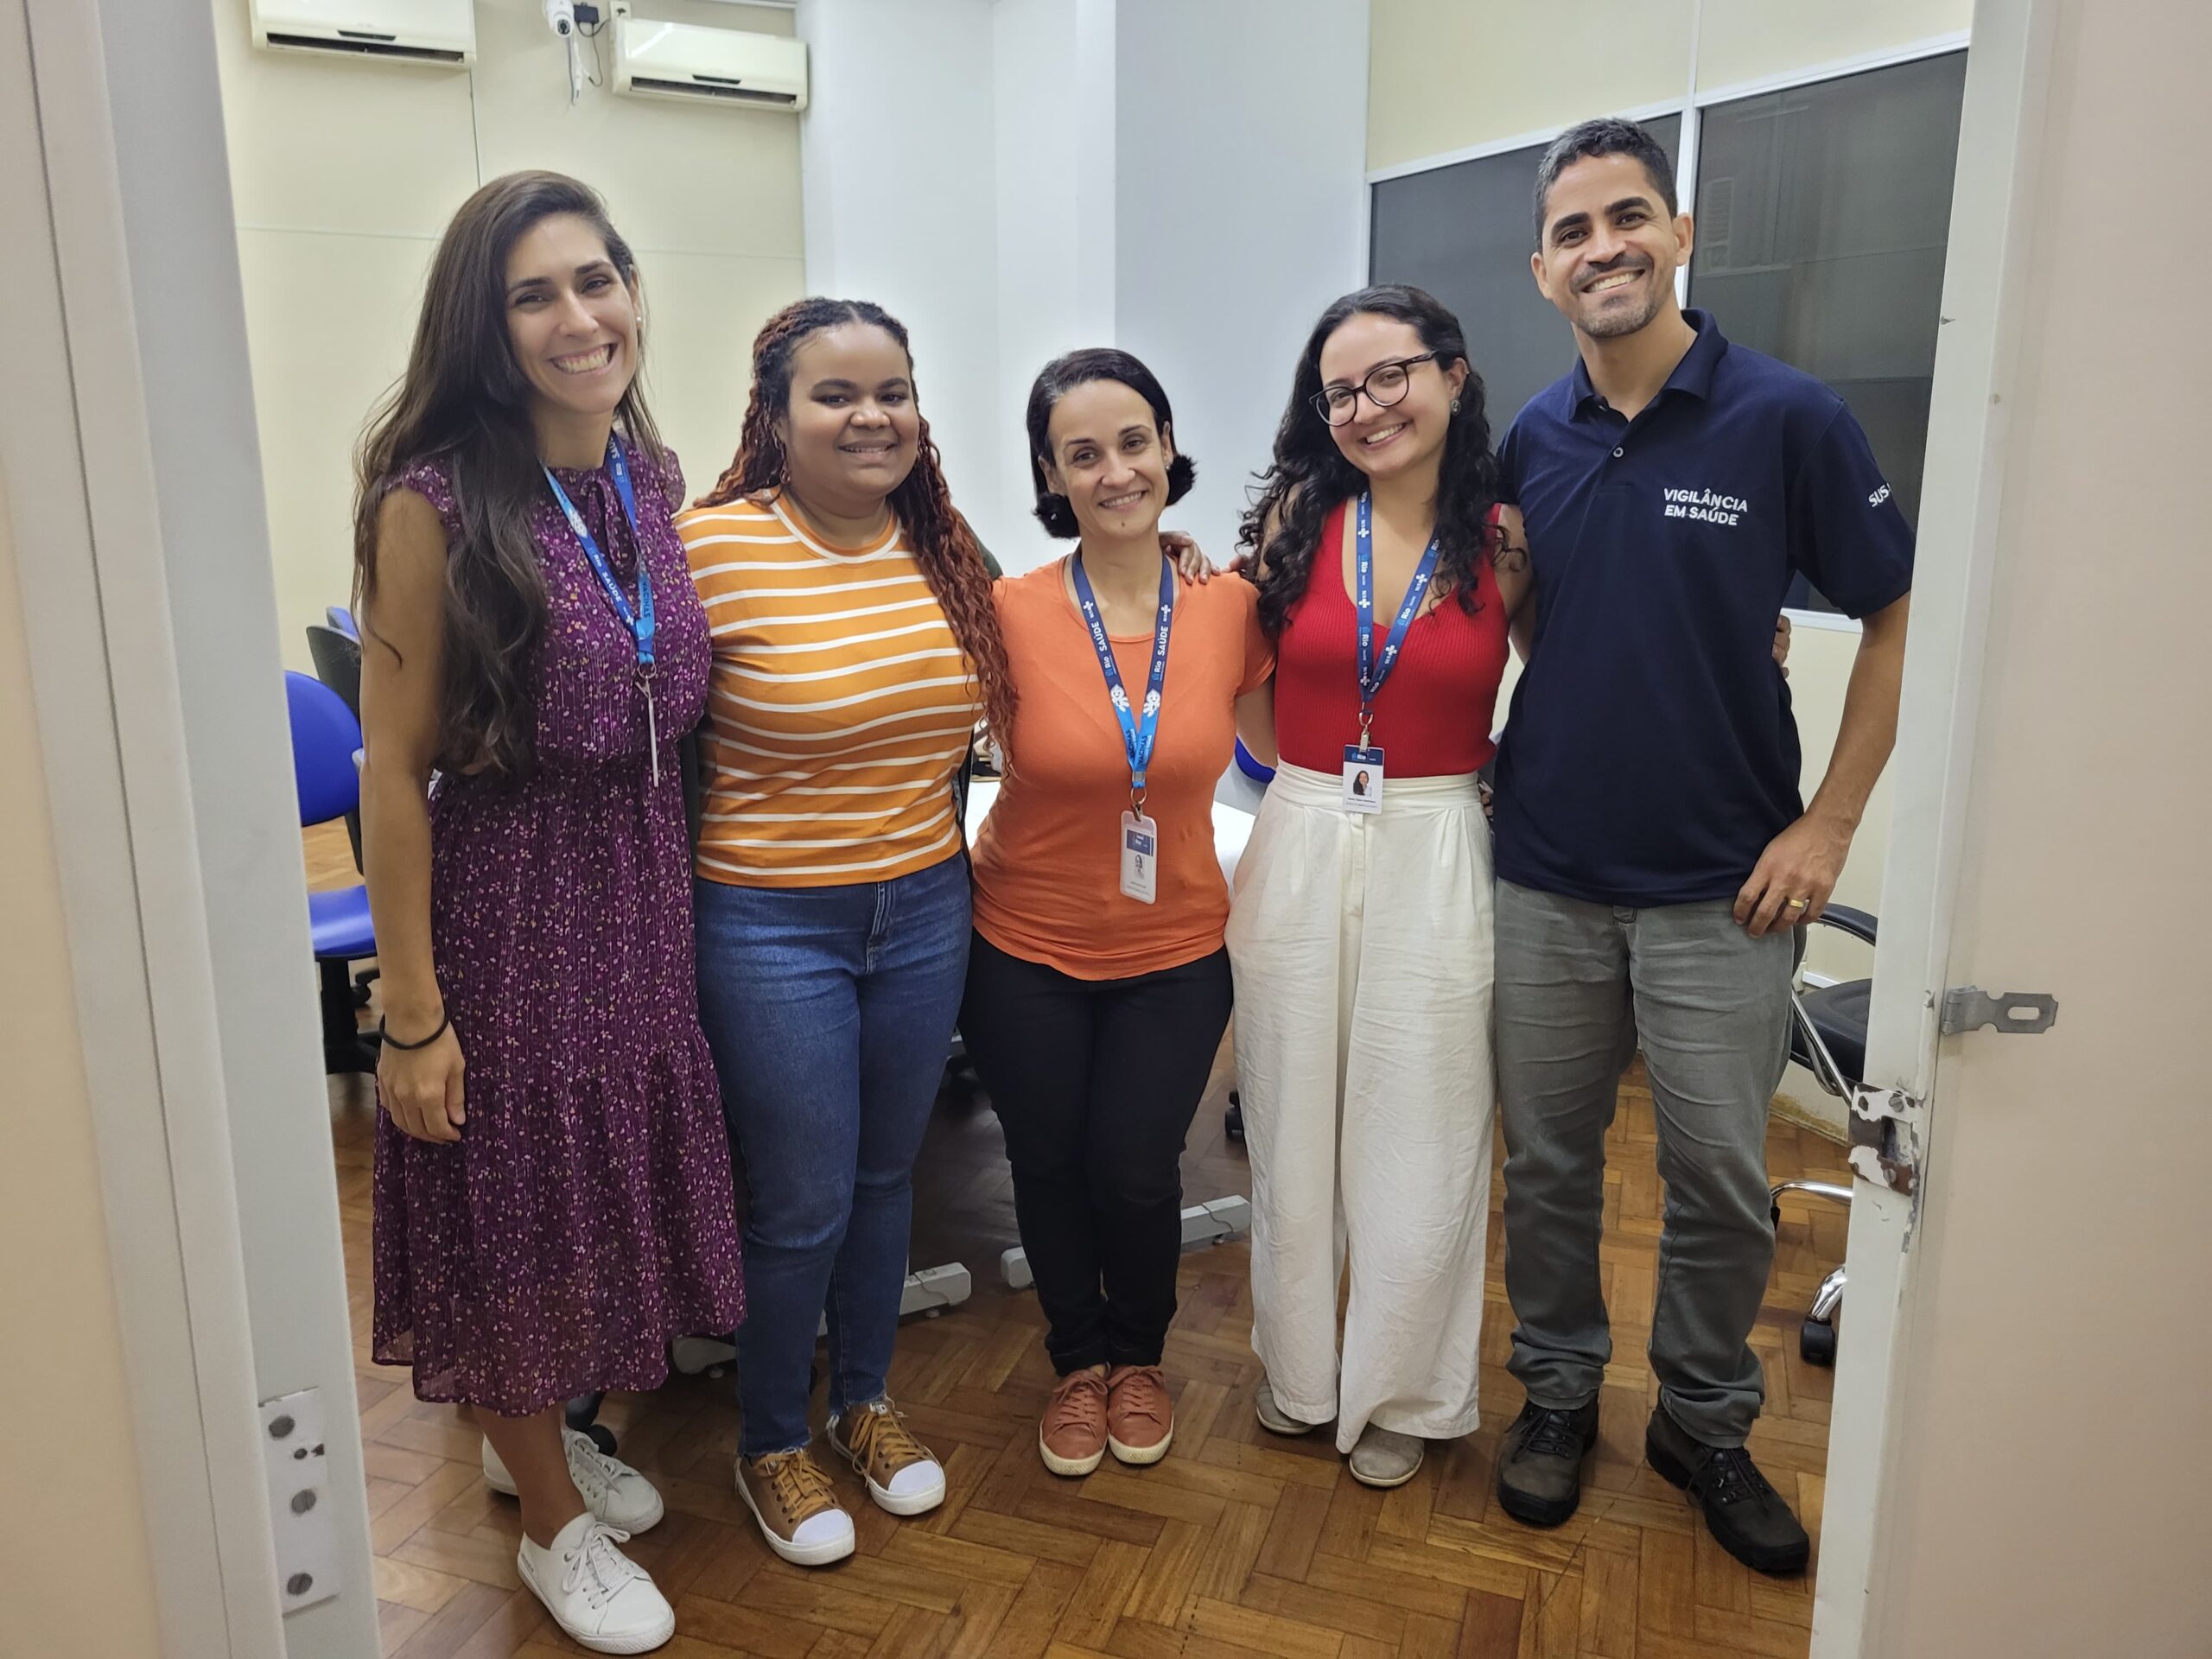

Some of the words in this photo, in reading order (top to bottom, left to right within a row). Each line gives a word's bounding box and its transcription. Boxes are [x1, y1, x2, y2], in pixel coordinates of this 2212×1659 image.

[1664, 487, 1748, 512] VIGILÂNCIA
[1664, 504, 1687, 518] EM
[1688, 506, 1739, 526] SAÚDE
[1090, 620, 1108, 652] SAÚDE
[1157, 626, 1168, 657] SAÚDE
